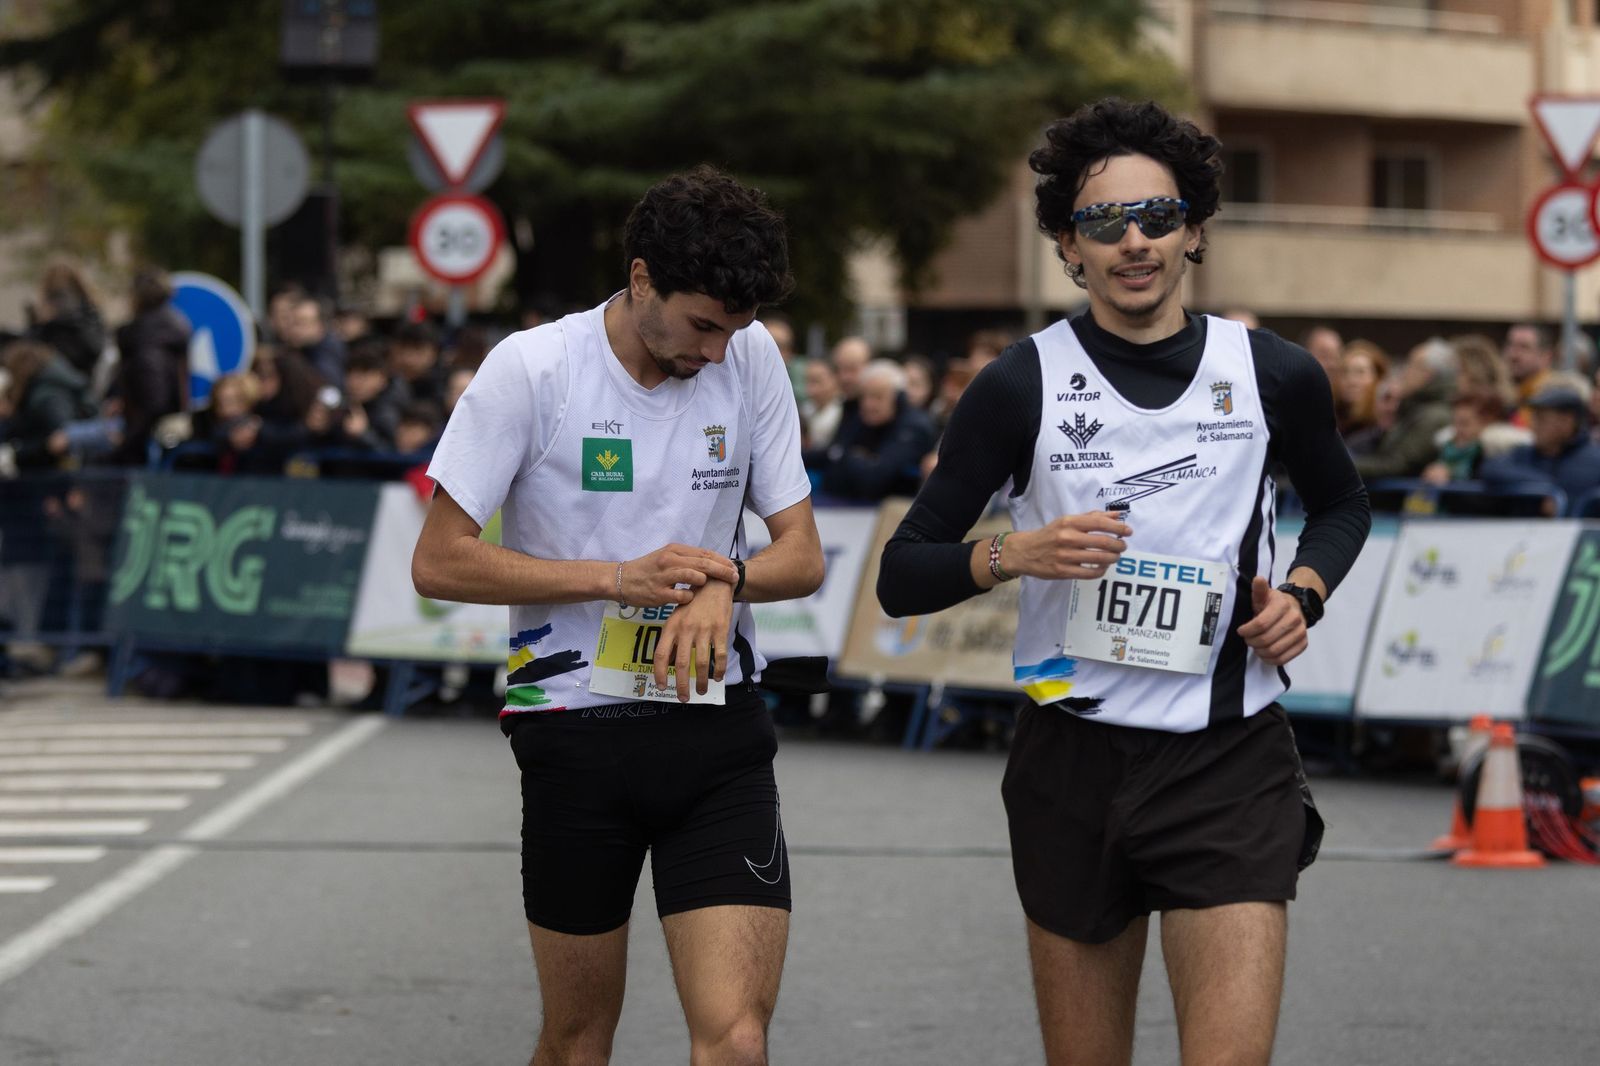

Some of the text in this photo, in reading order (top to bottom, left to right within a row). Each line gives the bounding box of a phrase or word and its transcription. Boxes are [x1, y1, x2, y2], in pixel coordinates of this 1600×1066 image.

[1056, 391, 1101, 402] VIATOR
[591, 419, 625, 435] EKT
[1196, 419, 1253, 432] Ayuntamiento
[1197, 432, 1253, 443] de Salamanca
[1049, 452, 1114, 463] CAJA RURAL
[1064, 462, 1114, 471] SALAMANCA
[691, 466, 740, 481] Ayuntamiento
[691, 479, 740, 491] de Salamanca
[1115, 556, 1212, 586] SETEL
[1096, 579, 1181, 631] 1670
[1096, 623, 1172, 641] ALEX MANZANO
[1128, 646, 1170, 658] Ayuntamiento
[1128, 654, 1169, 666] de Salamanca
[622, 663, 633, 672] EL
[581, 701, 657, 719] NIKE
